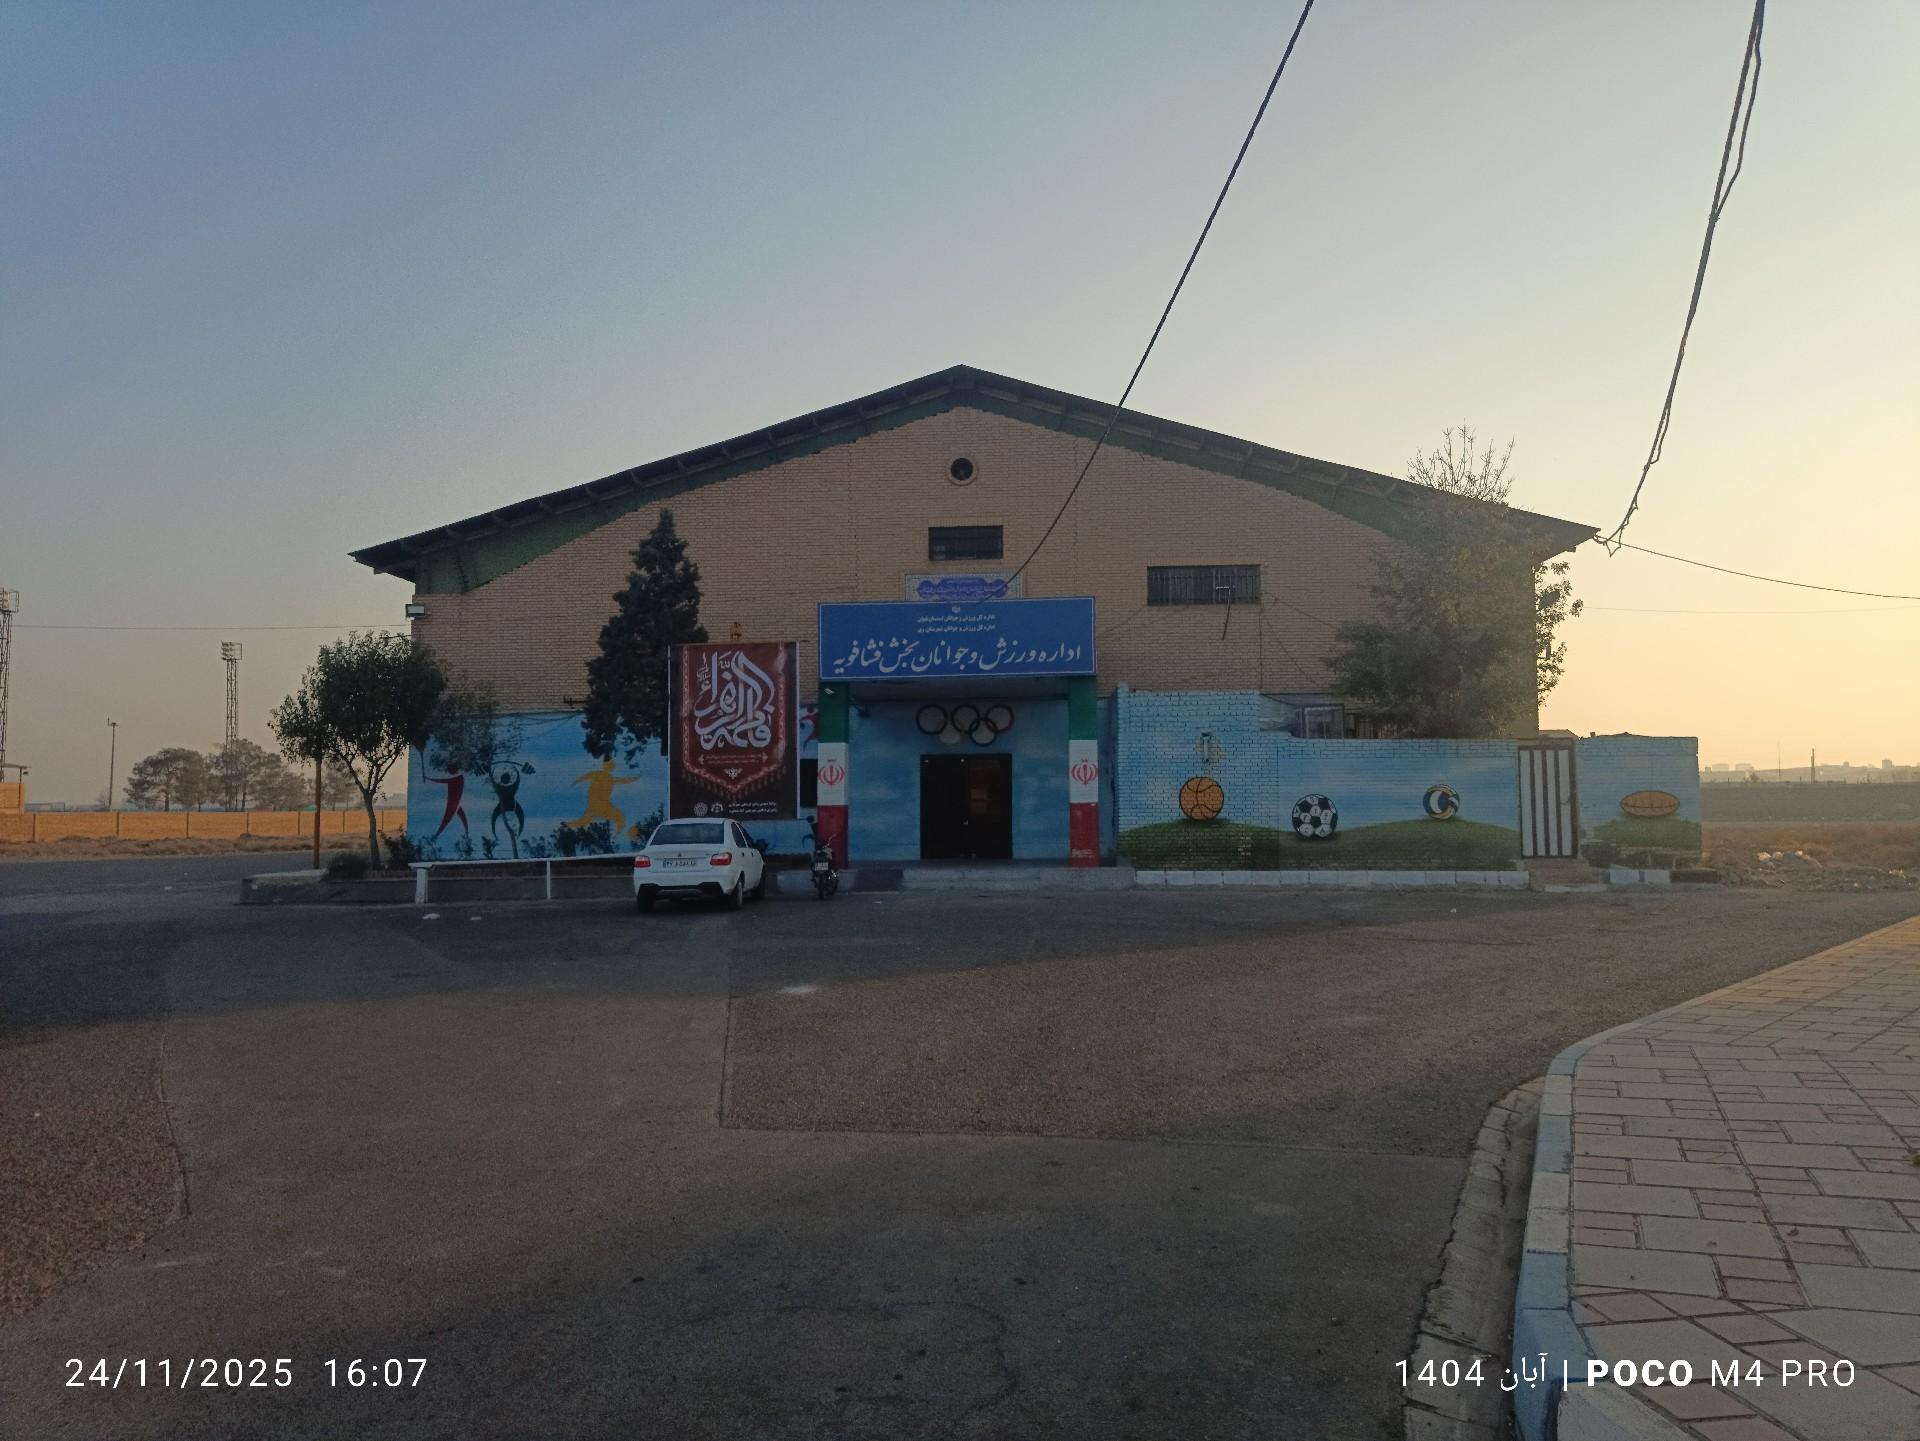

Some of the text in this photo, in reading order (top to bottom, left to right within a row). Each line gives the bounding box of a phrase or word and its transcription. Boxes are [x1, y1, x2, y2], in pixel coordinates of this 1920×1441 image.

[833, 637, 1081, 674] اداره ورزش و جوانان بخش فشافویه
